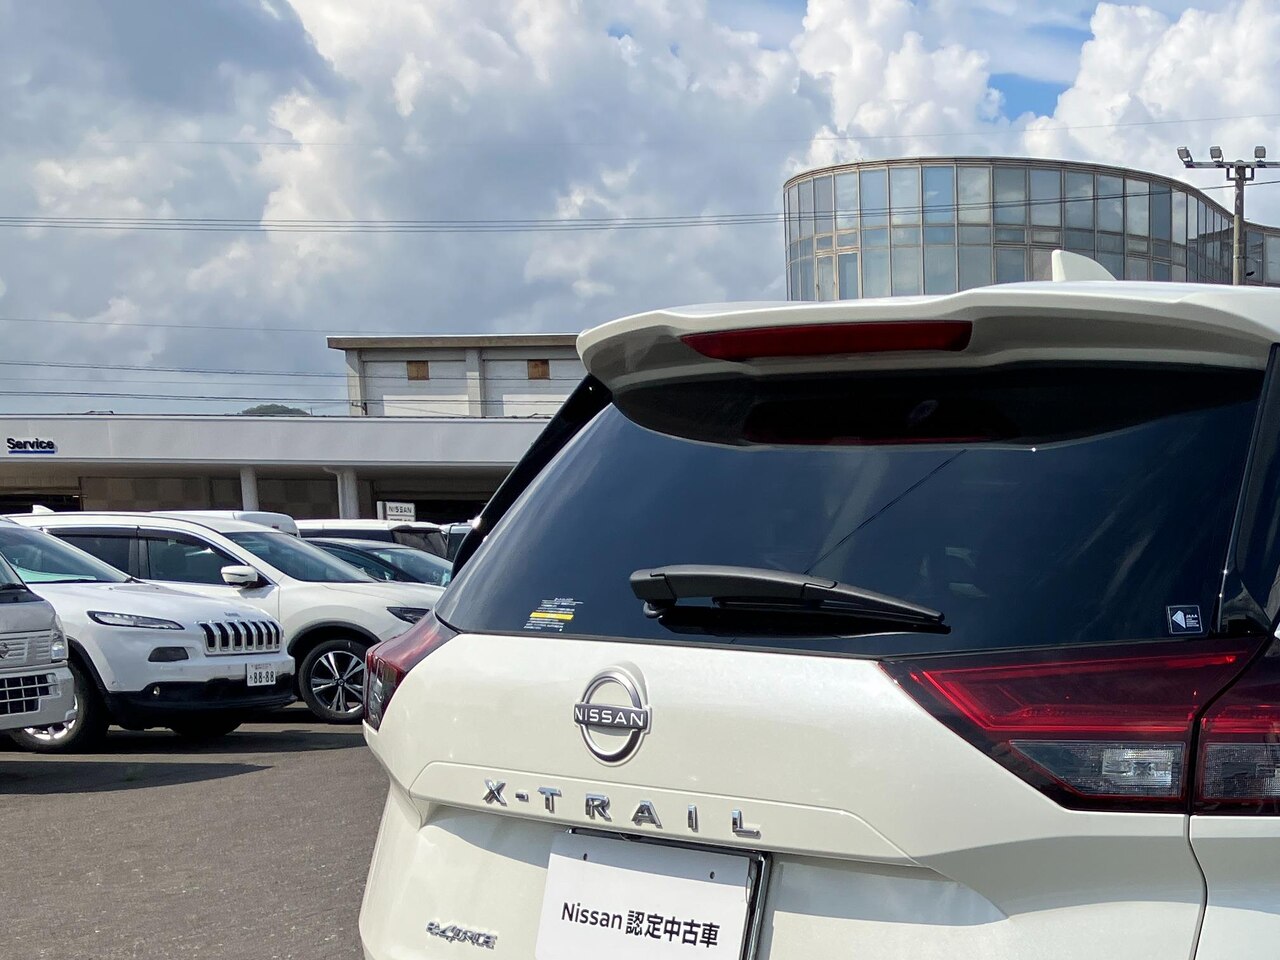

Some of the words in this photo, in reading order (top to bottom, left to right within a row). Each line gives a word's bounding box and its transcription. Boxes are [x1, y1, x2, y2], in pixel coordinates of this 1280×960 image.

[6, 437, 55, 450] Service
[574, 708, 646, 728] NISSAN
[482, 778, 763, 839] X-TRAIL
[560, 901, 623, 931] Nissan
[625, 909, 721, 949] 認定中古車
